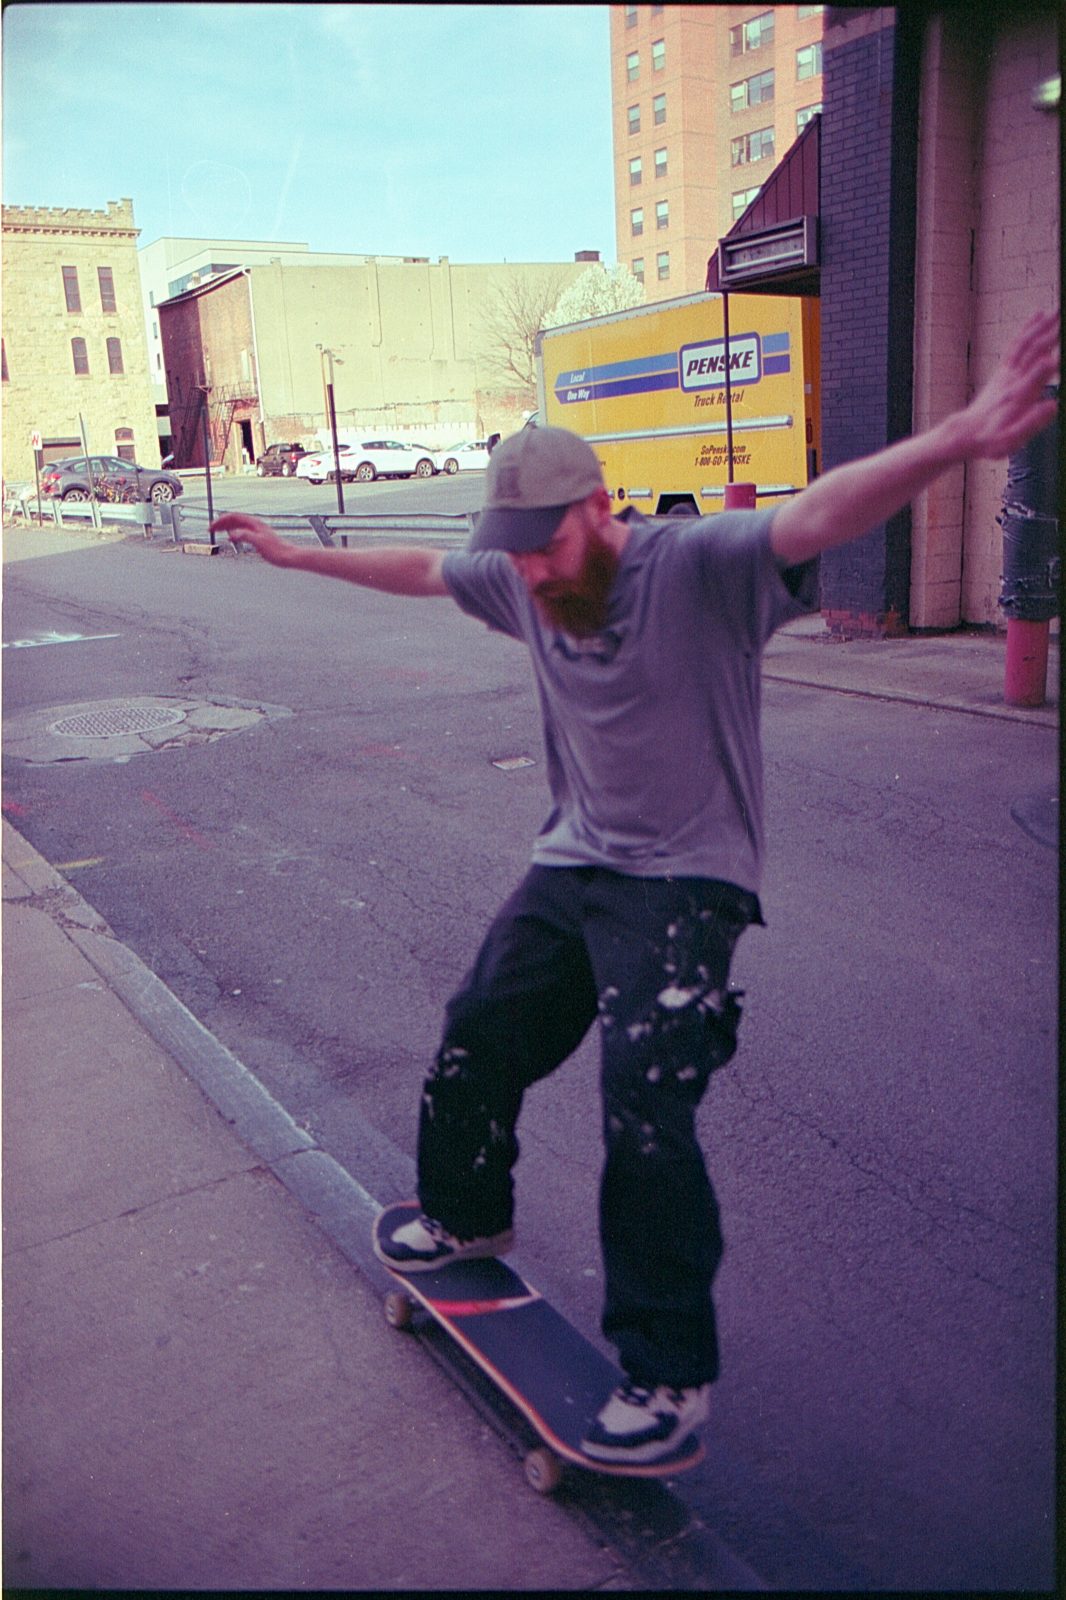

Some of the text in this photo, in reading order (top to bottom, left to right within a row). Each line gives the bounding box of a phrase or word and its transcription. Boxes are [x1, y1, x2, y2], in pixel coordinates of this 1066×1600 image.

[686, 350, 754, 377] PENSKE
[694, 389, 745, 407] Truck Retal
